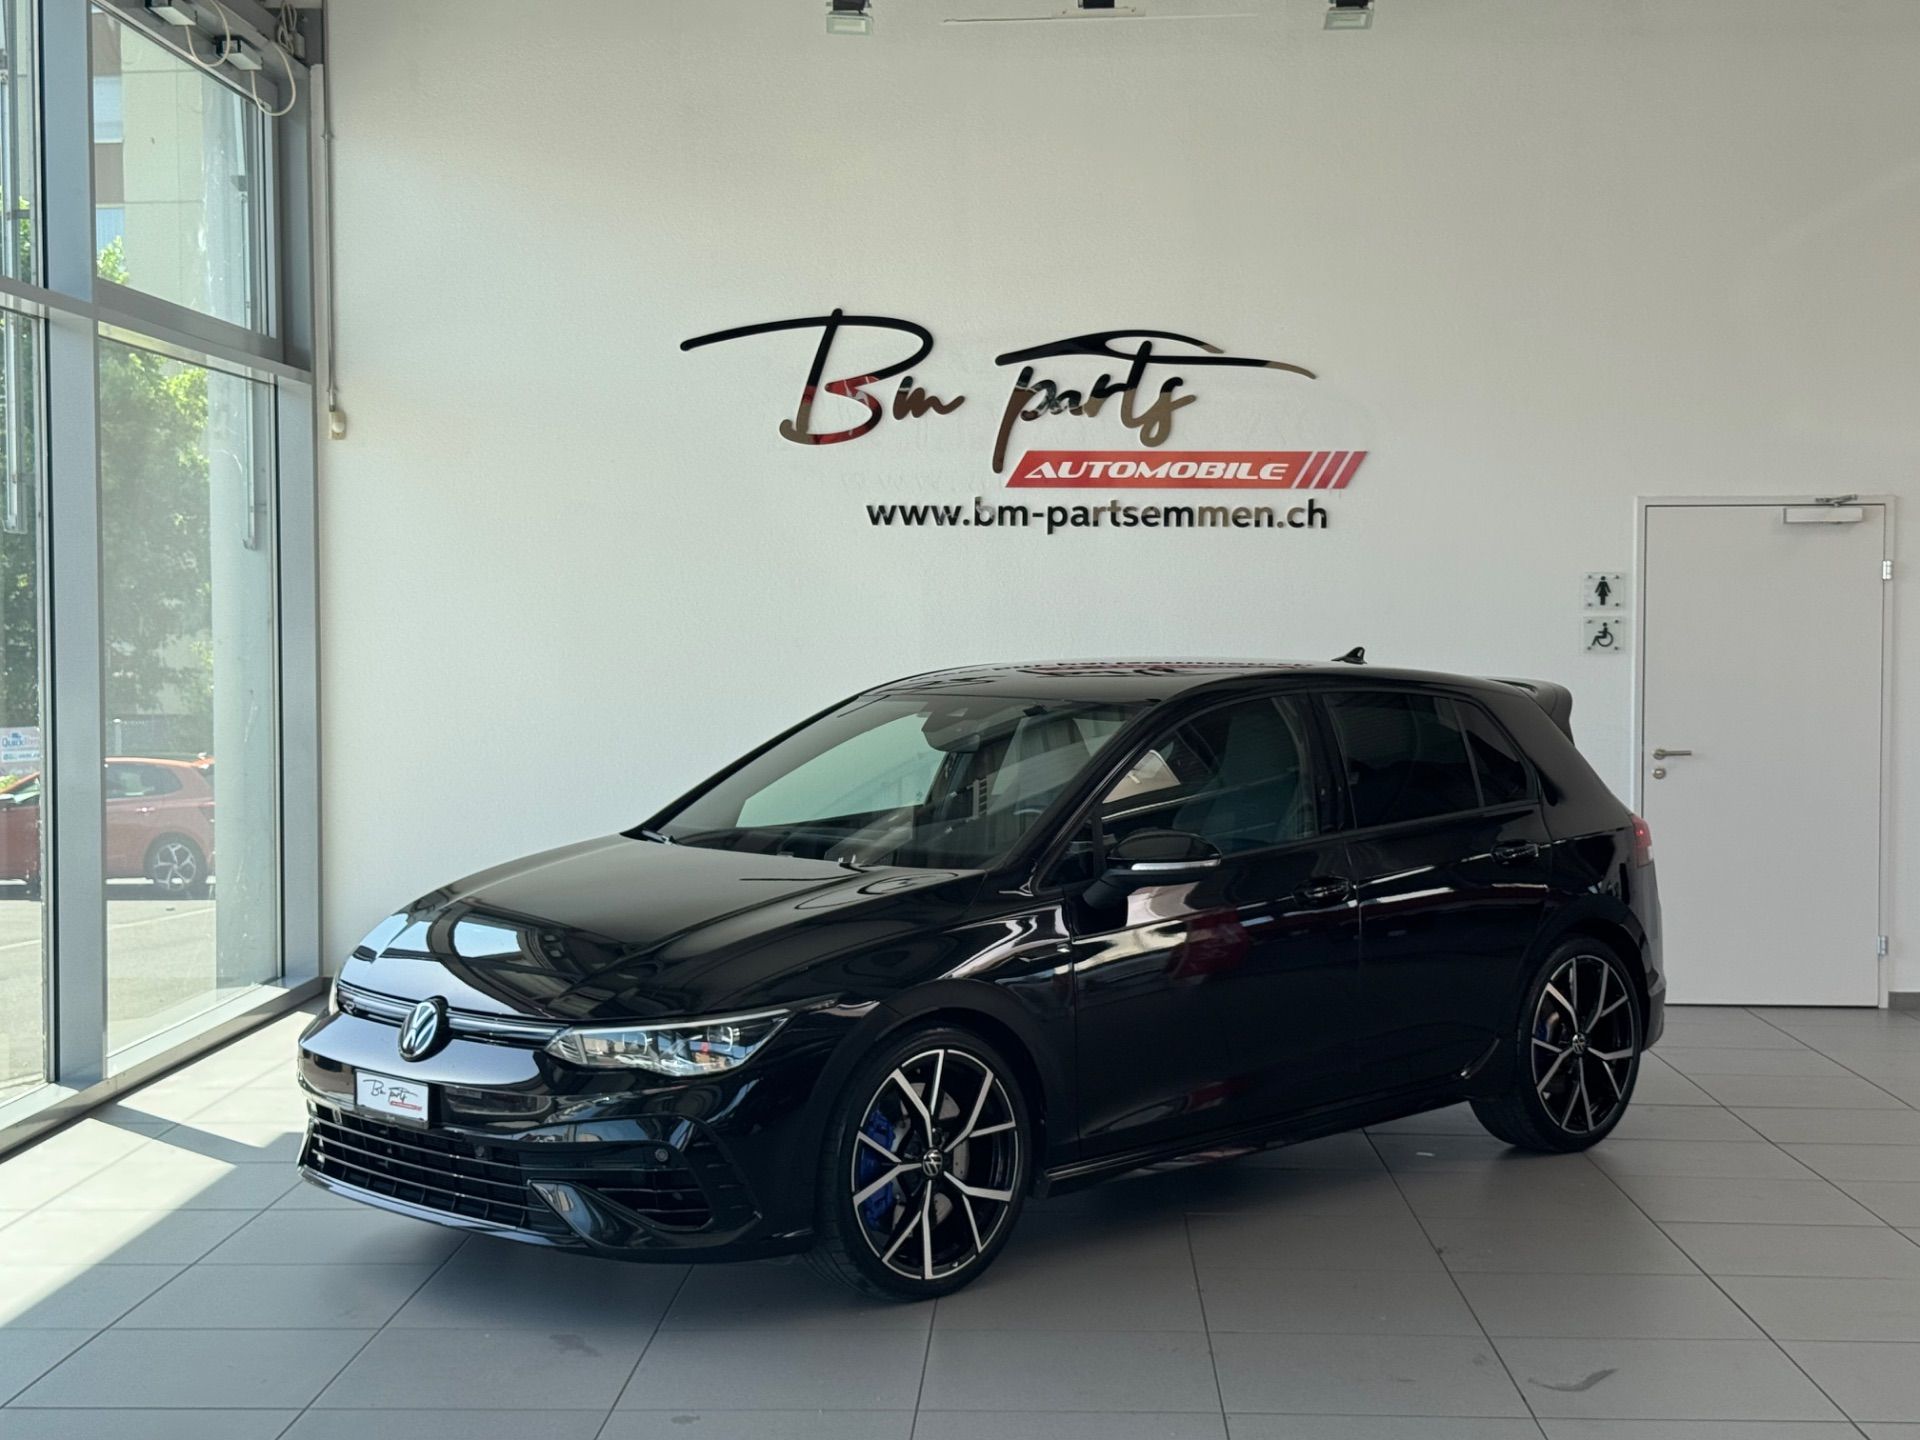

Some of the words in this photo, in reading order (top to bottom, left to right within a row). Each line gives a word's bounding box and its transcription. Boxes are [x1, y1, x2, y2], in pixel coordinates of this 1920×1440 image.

[681, 308, 967, 446] Bm
[992, 329, 1317, 474] parts
[1024, 461, 1290, 481] AUTOMOBILE
[866, 498, 1328, 534] www.bm-partsemmen.ch
